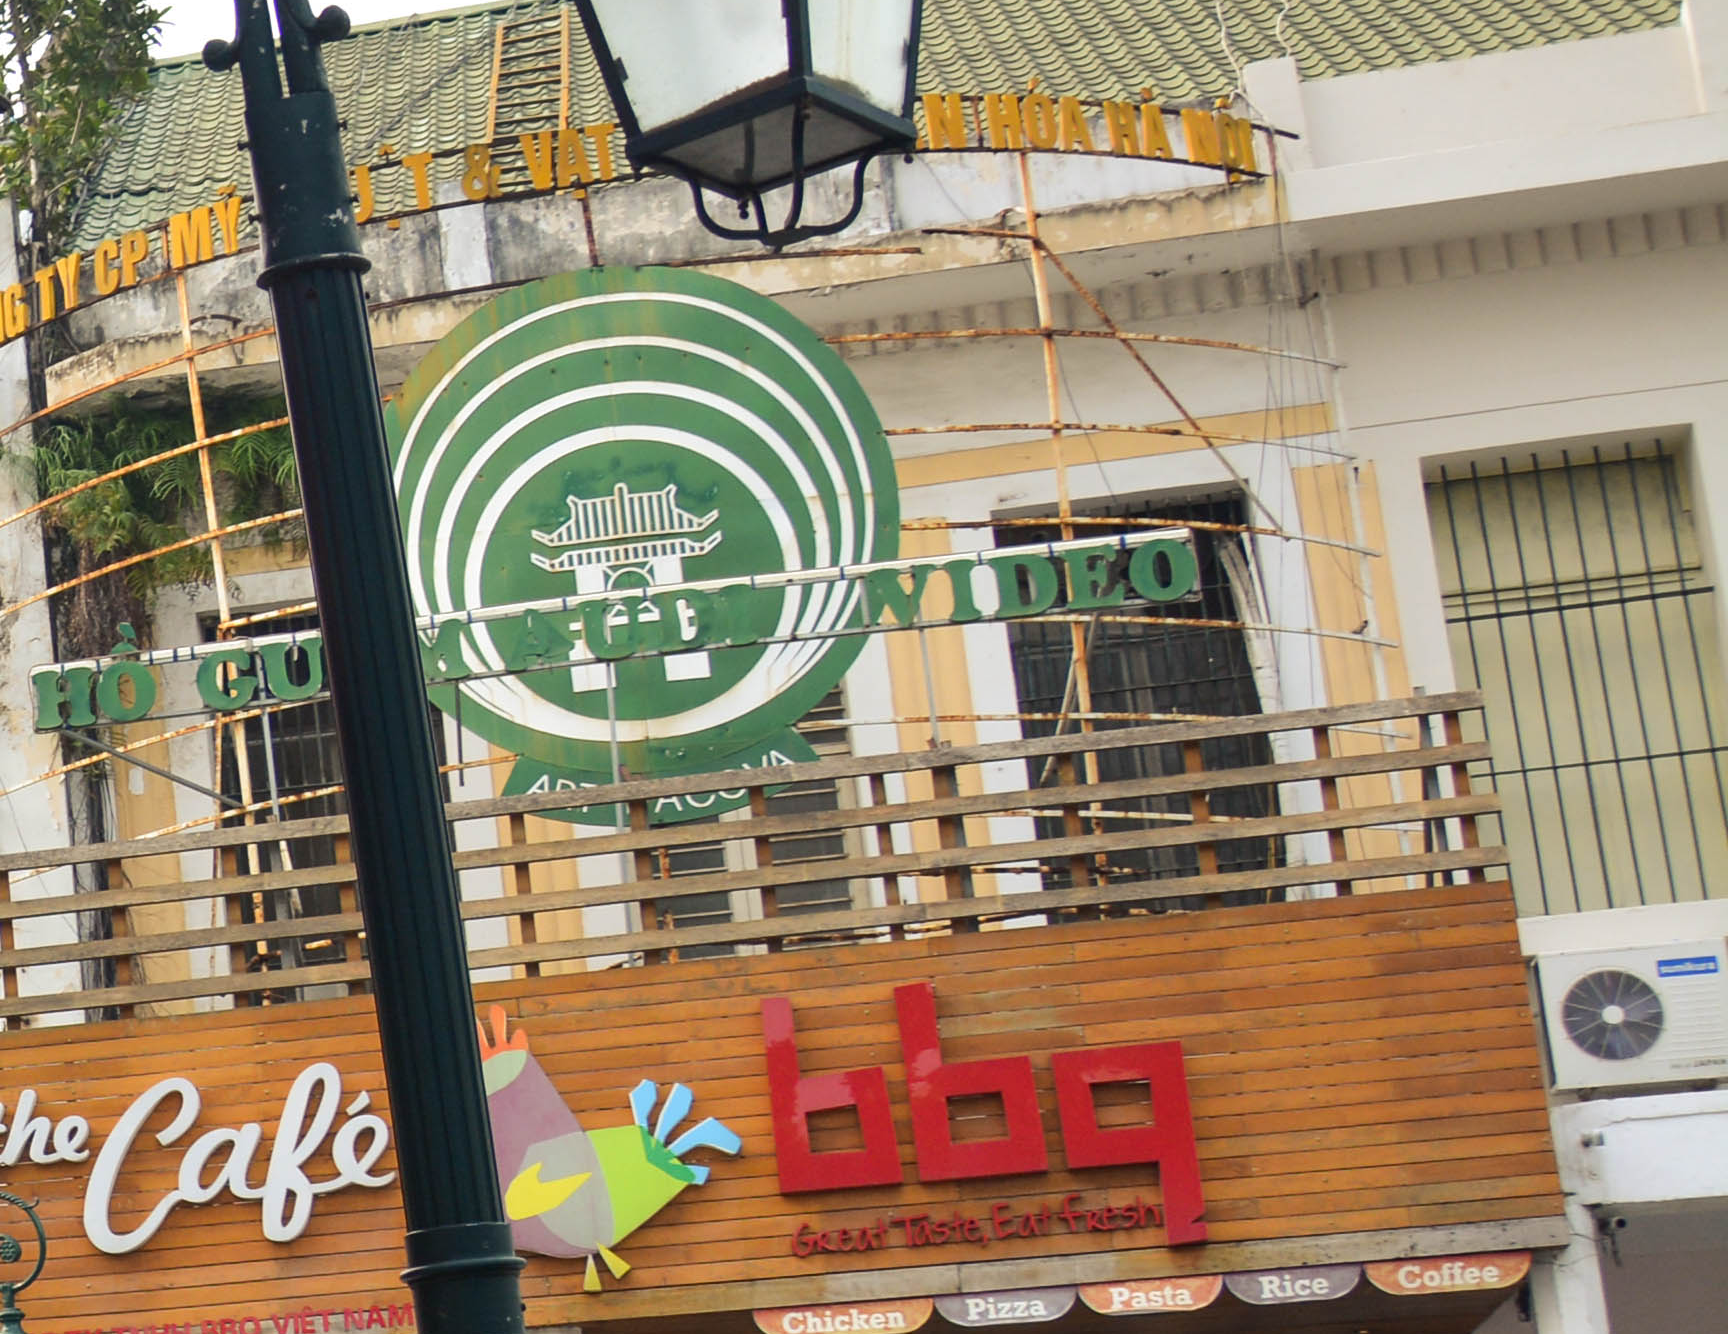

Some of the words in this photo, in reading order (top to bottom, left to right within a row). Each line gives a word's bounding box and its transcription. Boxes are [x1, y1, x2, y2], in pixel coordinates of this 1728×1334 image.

[34, 252, 81, 322] TY
[94, 230, 149, 296] CP
[867, 538, 1196, 628] VIDEO
[761, 980, 1207, 1246] bbq
[83, 1062, 396, 1255] Café
[1260, 1274, 1329, 1299] Rice
[1397, 1261, 1500, 1289] Coffee
[967, 1297, 1046, 1322] Pizza
[1110, 1286, 1193, 1309] Pasta
[343, 1302, 415, 1332] NAM
[782, 1310, 905, 1334] Chicken
